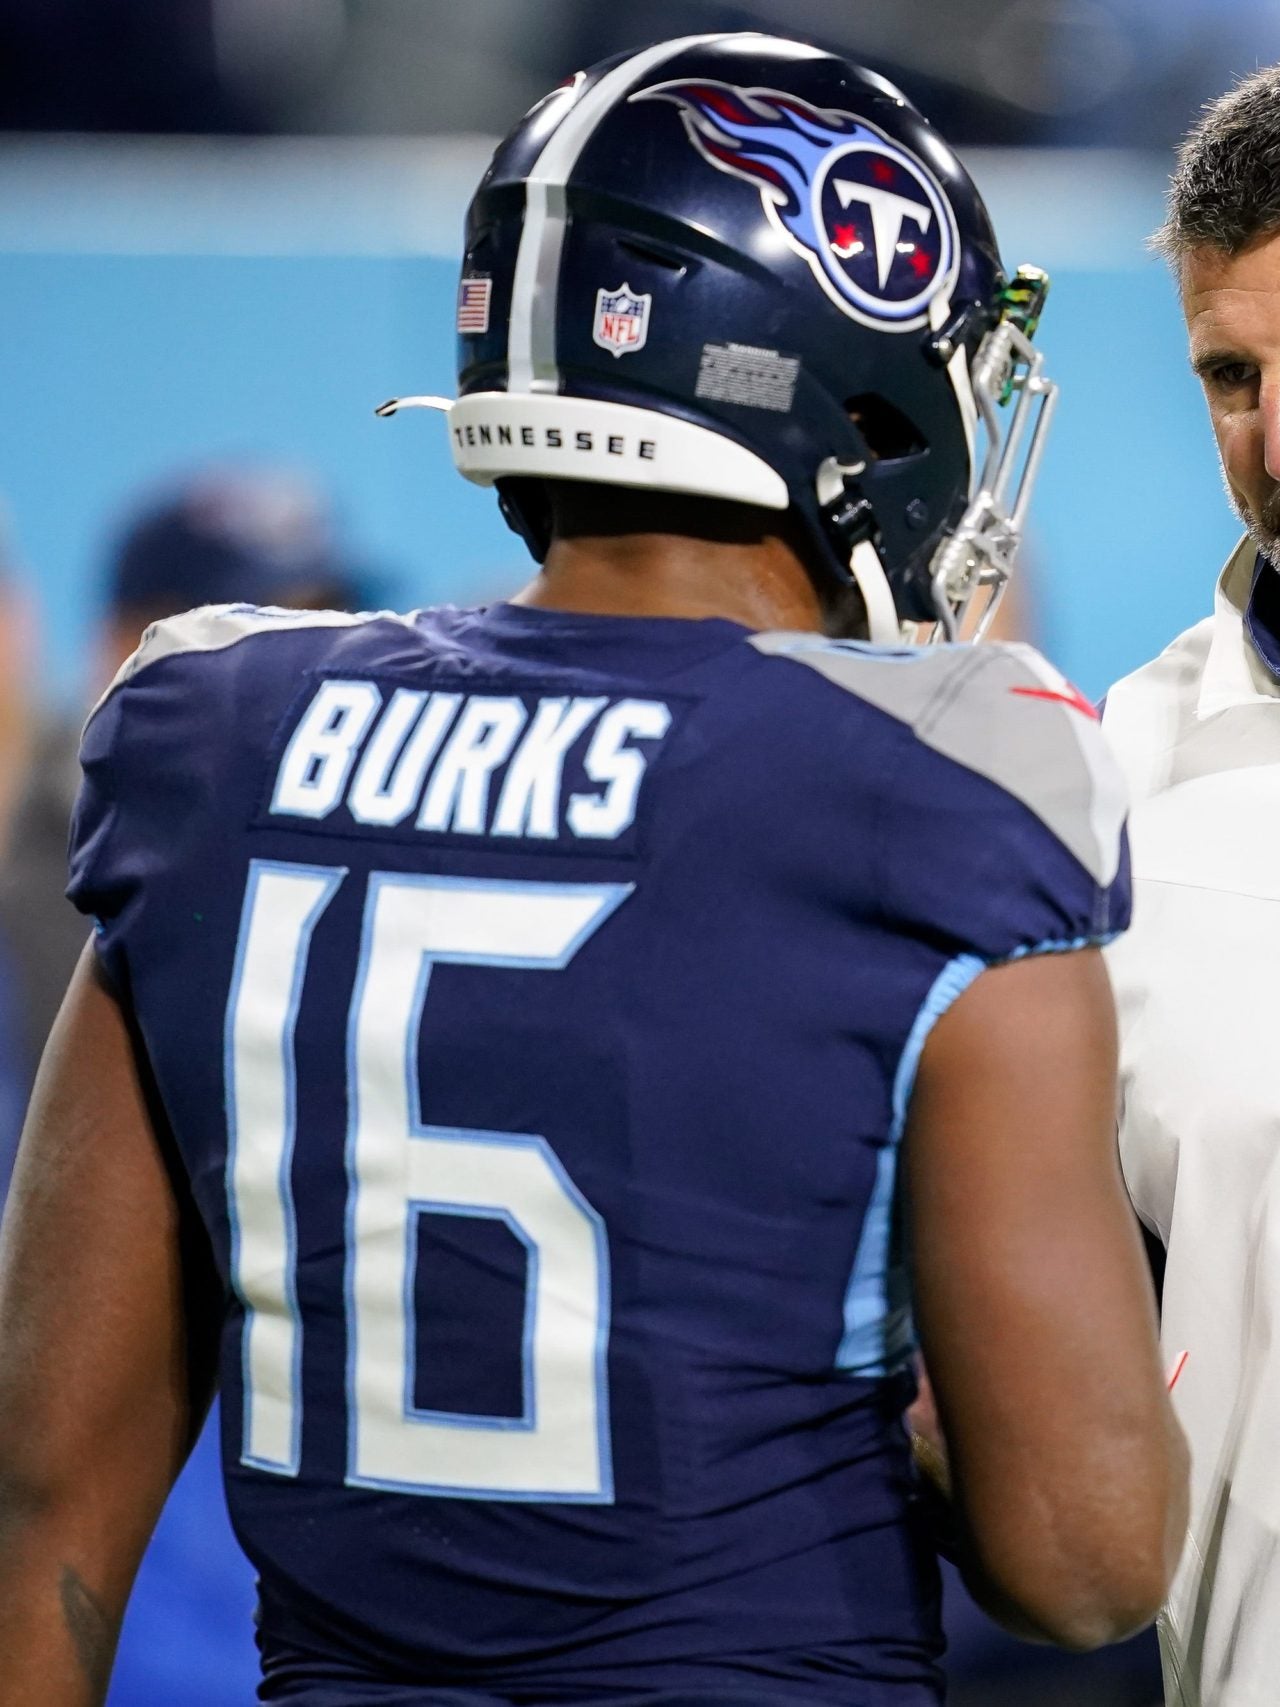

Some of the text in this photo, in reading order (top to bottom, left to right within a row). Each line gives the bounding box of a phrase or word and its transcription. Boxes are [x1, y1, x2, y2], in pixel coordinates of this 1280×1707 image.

[832, 178, 932, 290] T
[600, 314, 637, 343] NFL
[454, 424, 657, 460] TENNESSEE
[269, 679, 672, 840] BURKS
[223, 858, 636, 1504] 16
